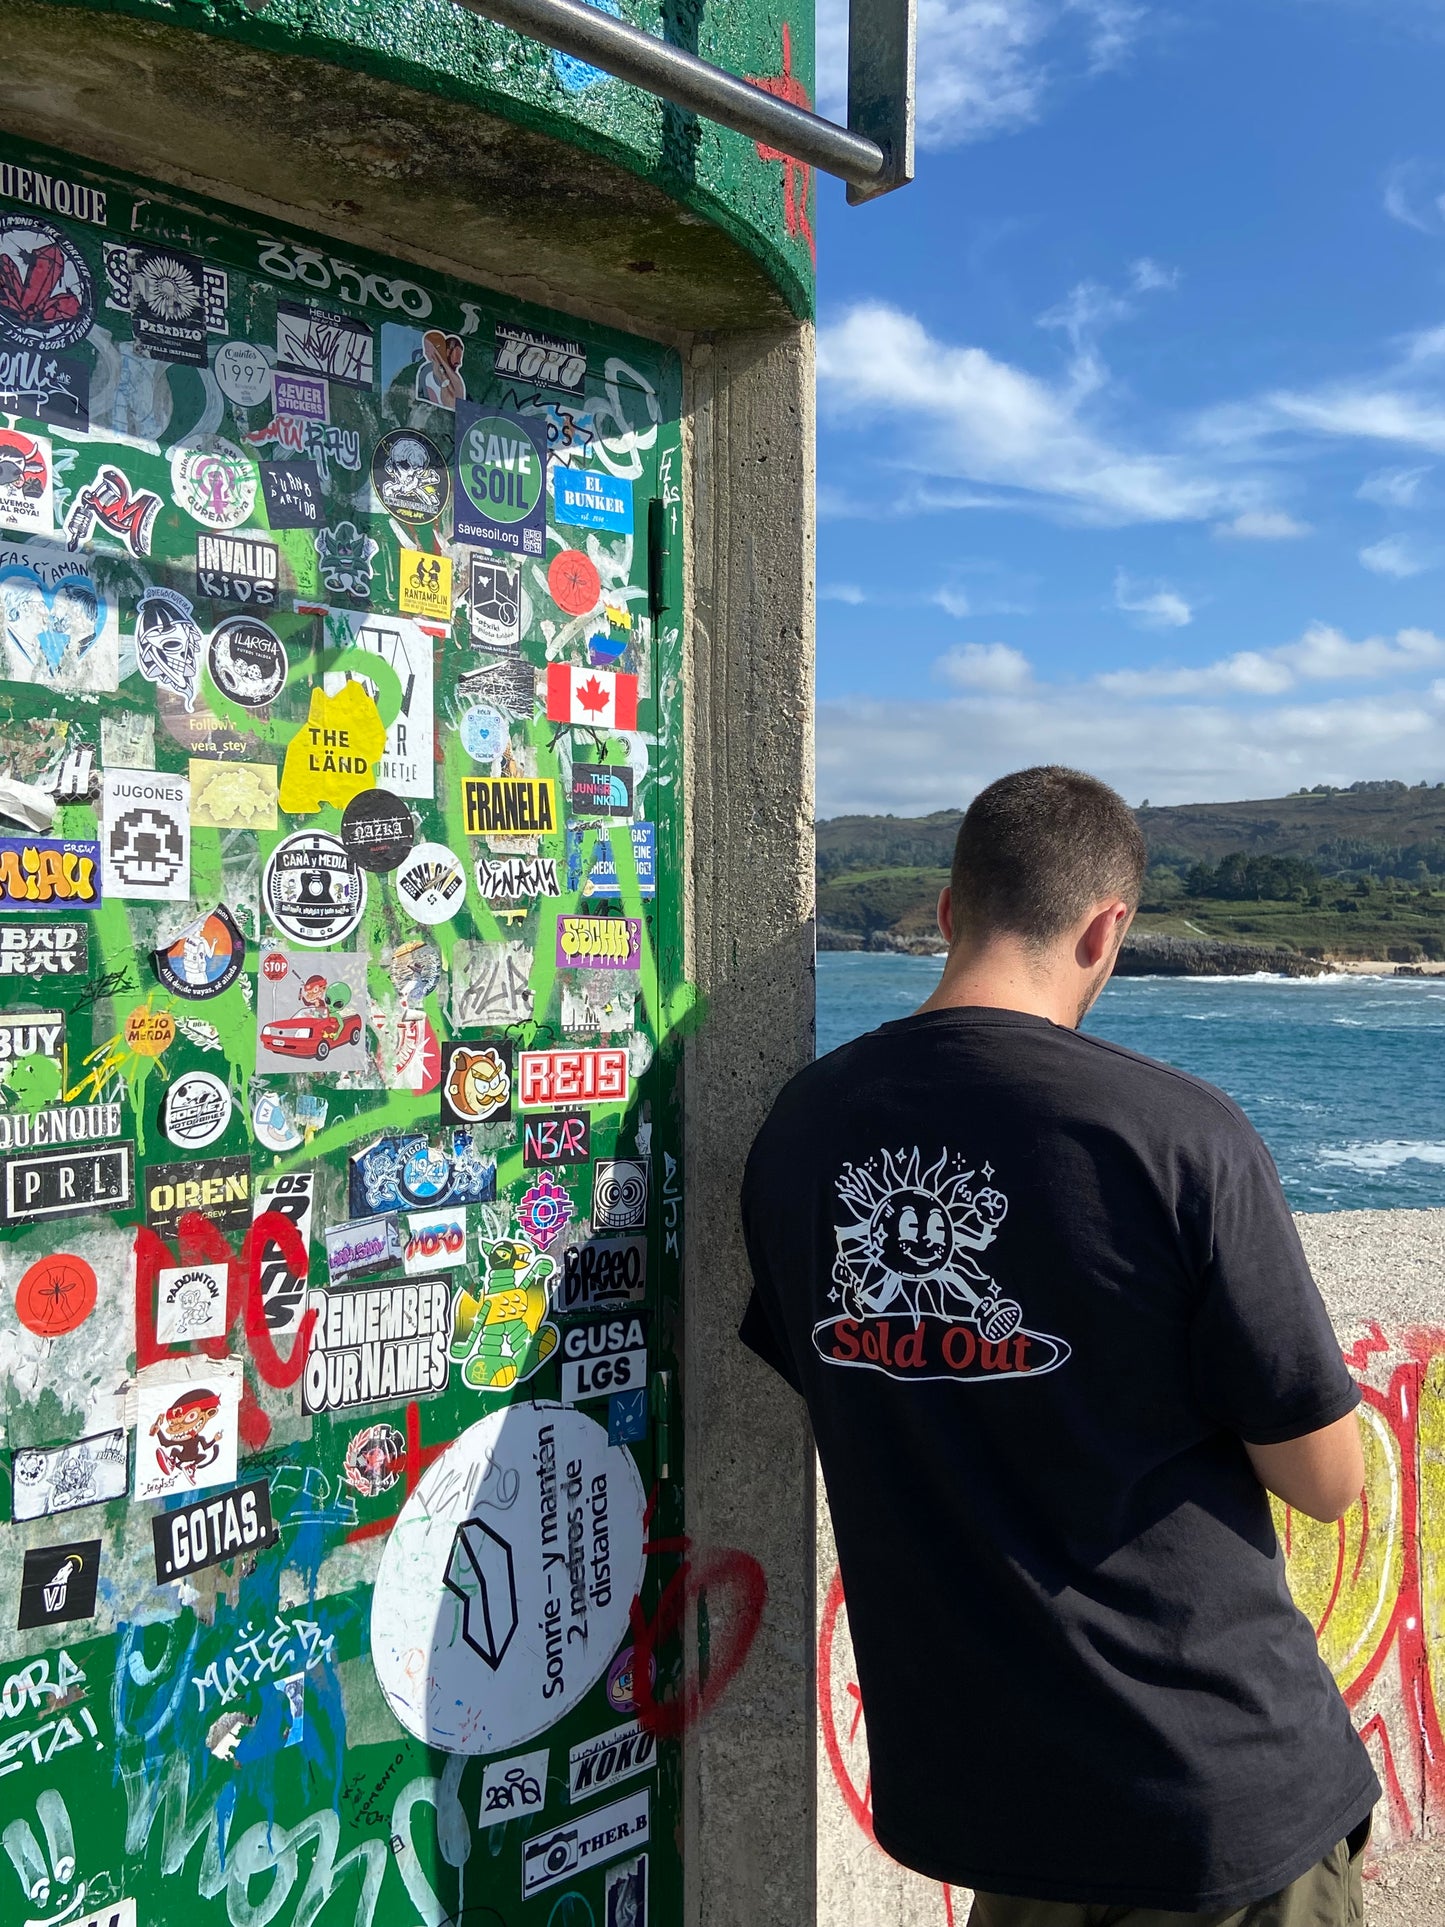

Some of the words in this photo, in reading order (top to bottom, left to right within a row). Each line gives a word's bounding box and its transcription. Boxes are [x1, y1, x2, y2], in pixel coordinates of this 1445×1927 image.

[310, 308, 341, 323] HELLO
[220, 363, 266, 385] 1997
[496, 339, 588, 388] KOKO
[278, 382, 321, 402] 4EVER
[278, 396, 324, 415] STICKERS
[469, 428, 531, 475] SAVE
[470, 464, 530, 510] SOIL
[585, 476, 604, 493] EL
[14, 506, 39, 517] ROYA!
[187, 495, 232, 523] GUREAK
[563, 490, 625, 514] BUNKER
[458, 522, 519, 546] savesoil.org
[198, 535, 277, 581] INVALID
[404, 587, 448, 606] RANTAMPLIN
[234, 632, 280, 656] ILARGIA
[308, 728, 350, 749] THE
[309, 750, 368, 775] LÄND
[573, 783, 611, 796] JUNIOR
[591, 773, 610, 784] THE
[112, 783, 184, 802] JUGONES
[593, 795, 611, 806] INK
[465, 780, 553, 832] FRANELA
[353, 822, 403, 843] NAZKA
[63, 843, 96, 854] CREW
[283, 852, 310, 868] CAÑA
[311, 856, 317, 867] y
[318, 854, 348, 870] MEDIA
[1, 928, 78, 951] BAD
[0, 951, 77, 975] RAT
[264, 961, 288, 974] STOP
[522, 1050, 627, 1105] REIS
[169, 1100, 227, 1124] ROCKET
[409, 1158, 445, 1178] 1921
[259, 1175, 313, 1195] LOS
[202, 1210, 227, 1219] CREW
[166, 1271, 220, 1304] PADDINTON
[308, 1284, 447, 1351] REMEMBER
[564, 1318, 645, 1359] GUSA
[832, 1318, 928, 1368] Sold
[941, 1326, 1032, 1372] Out
[305, 1348, 361, 1410] OUR
[360, 1331, 447, 1400] NAMES
[577, 1356, 632, 1393] LGS
[585, 1472, 612, 1609] distancia
[567, 1620, 589, 1645] 2
[578, 1814, 648, 1858] THER.B
